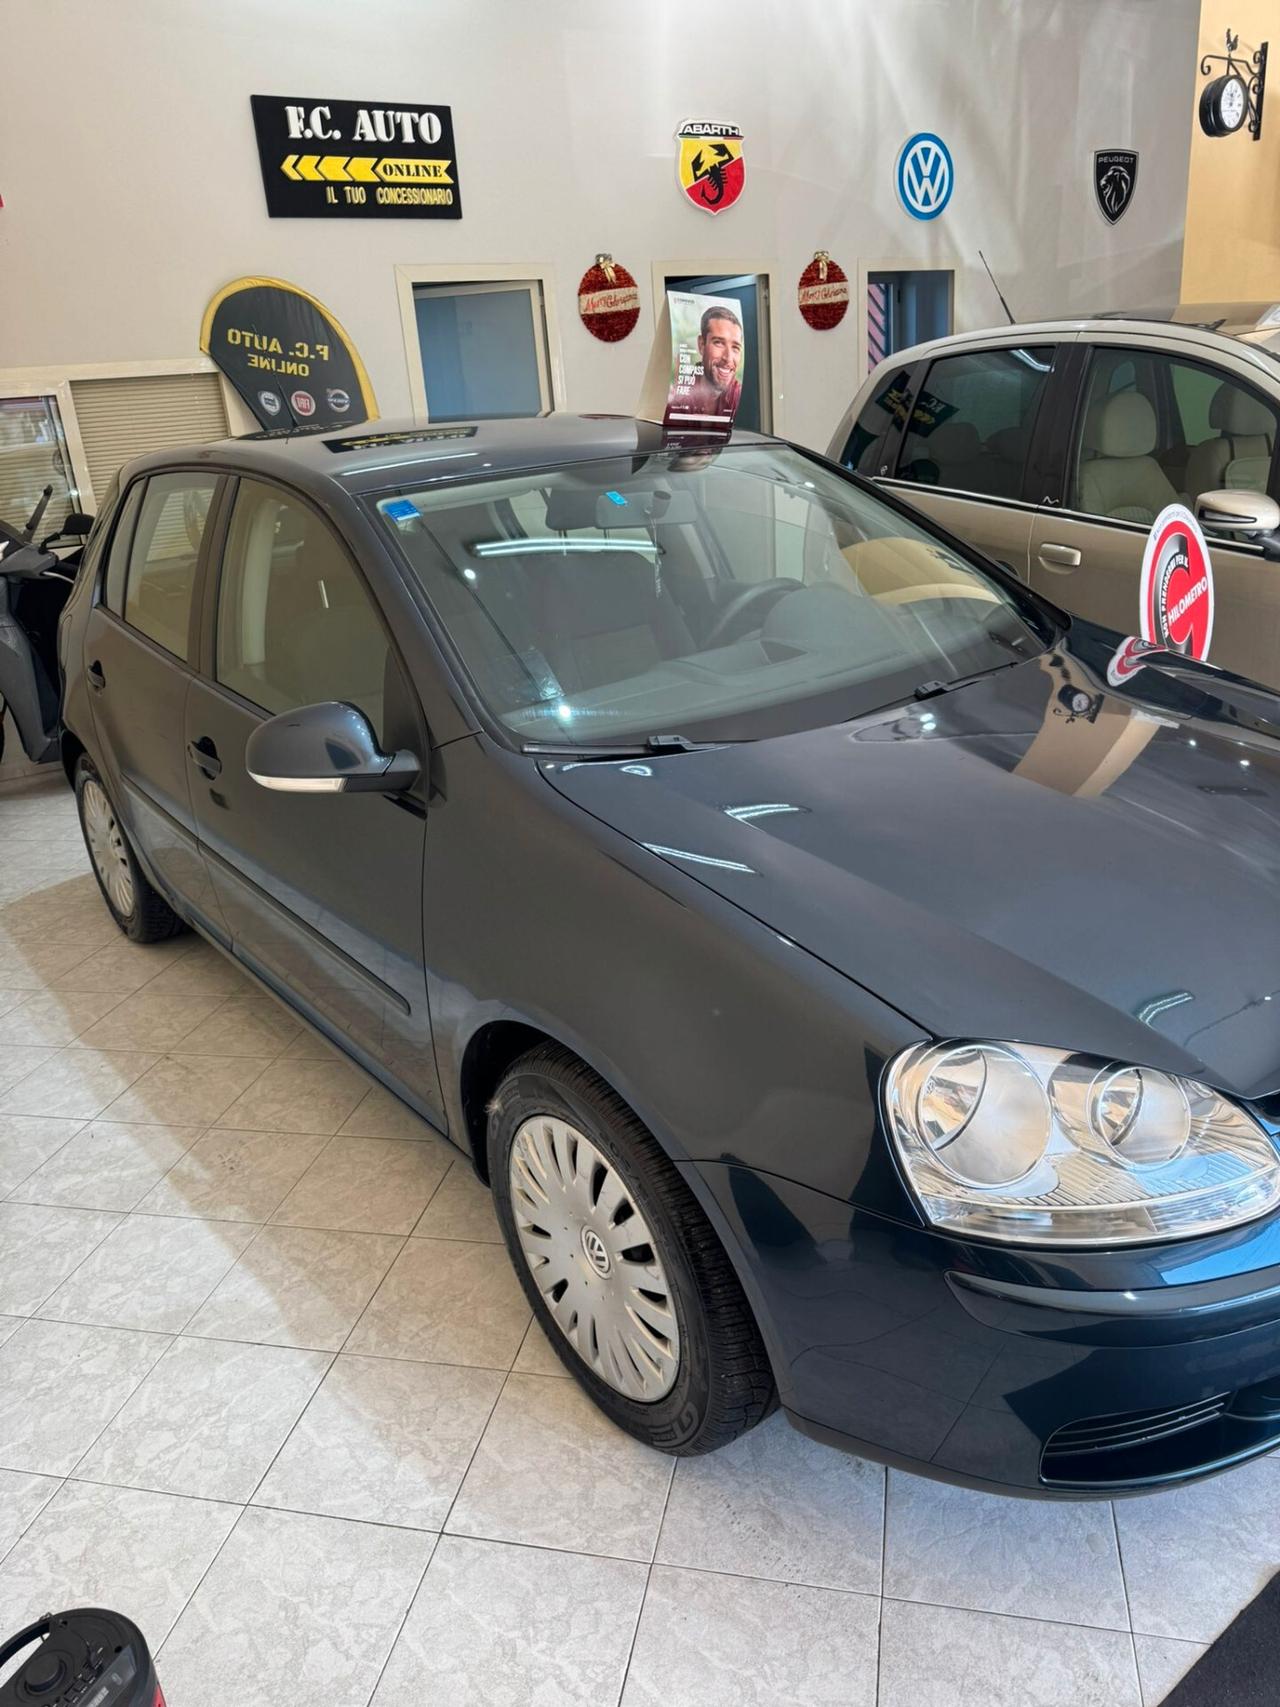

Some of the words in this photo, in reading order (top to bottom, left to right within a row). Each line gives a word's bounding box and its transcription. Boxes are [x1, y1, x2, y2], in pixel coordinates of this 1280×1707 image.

[285, 106, 341, 140] F.C.
[352, 109, 442, 144] AUTO
[683, 124, 739, 135] ABARTH
[1098, 155, 1134, 163] PEUGEOT
[382, 163, 442, 178] ONLINE
[326, 186, 339, 204] IL
[343, 186, 366, 205] TUO
[376, 186, 453, 206] CONCESSIONARIO
[678, 365, 704, 376] COMPASS
